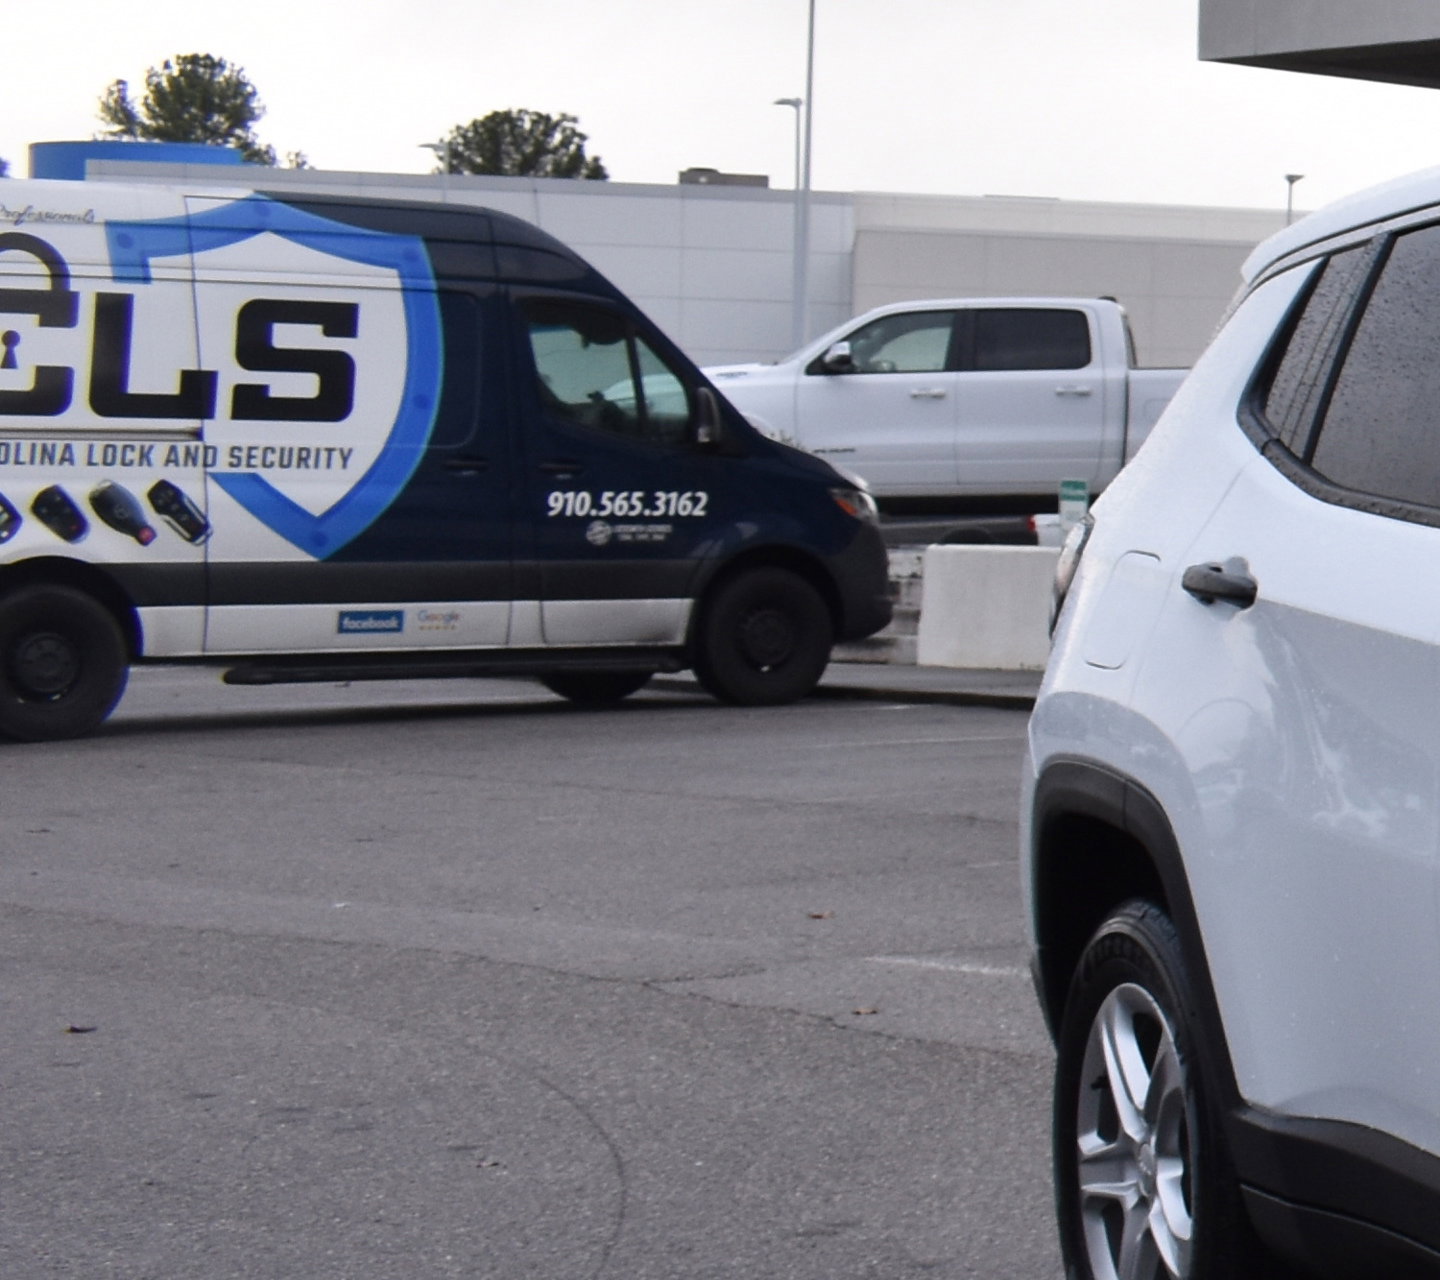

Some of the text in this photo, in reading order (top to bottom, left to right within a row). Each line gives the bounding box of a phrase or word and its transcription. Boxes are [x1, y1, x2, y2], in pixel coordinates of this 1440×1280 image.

[86, 443, 155, 467] LOCK
[164, 444, 218, 469] AND
[228, 445, 354, 470] SECURITY
[547, 491, 708, 517] 910.565.3162
[343, 616, 399, 629] facebook
